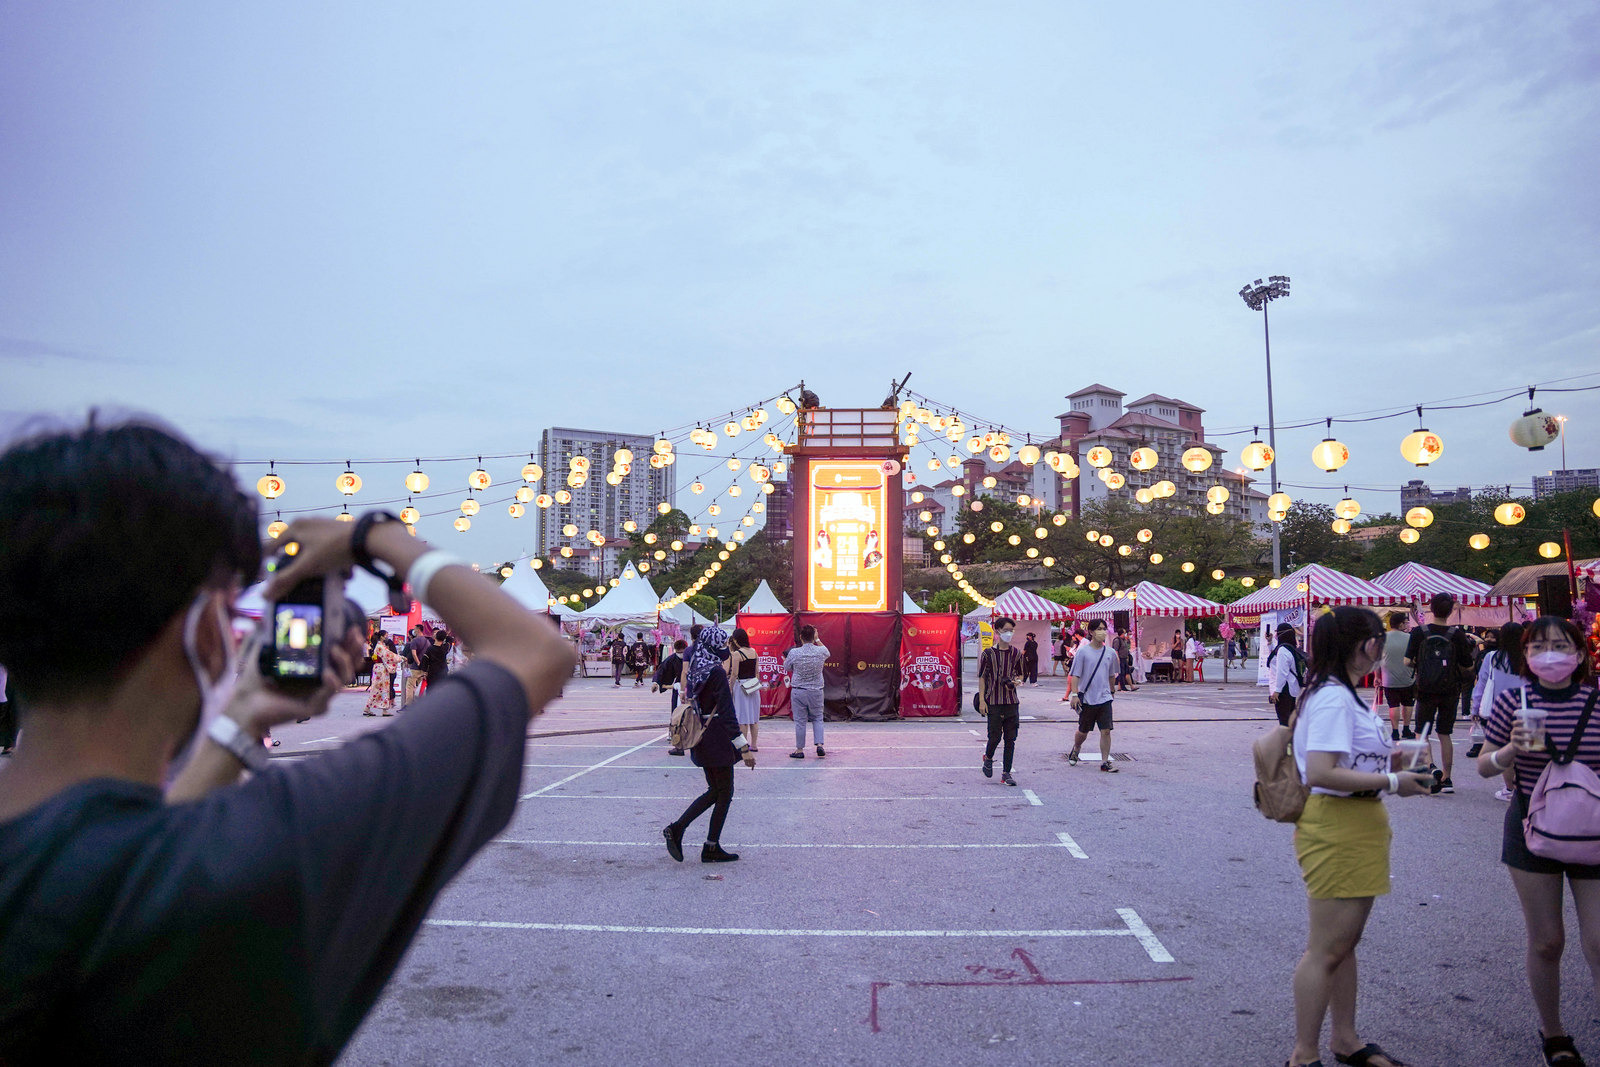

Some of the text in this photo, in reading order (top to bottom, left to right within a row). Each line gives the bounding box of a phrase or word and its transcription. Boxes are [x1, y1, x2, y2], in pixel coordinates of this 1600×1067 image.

[758, 656, 778, 665] IHON
[916, 656, 940, 665] NIHON
[905, 664, 951, 675] MATSURI
